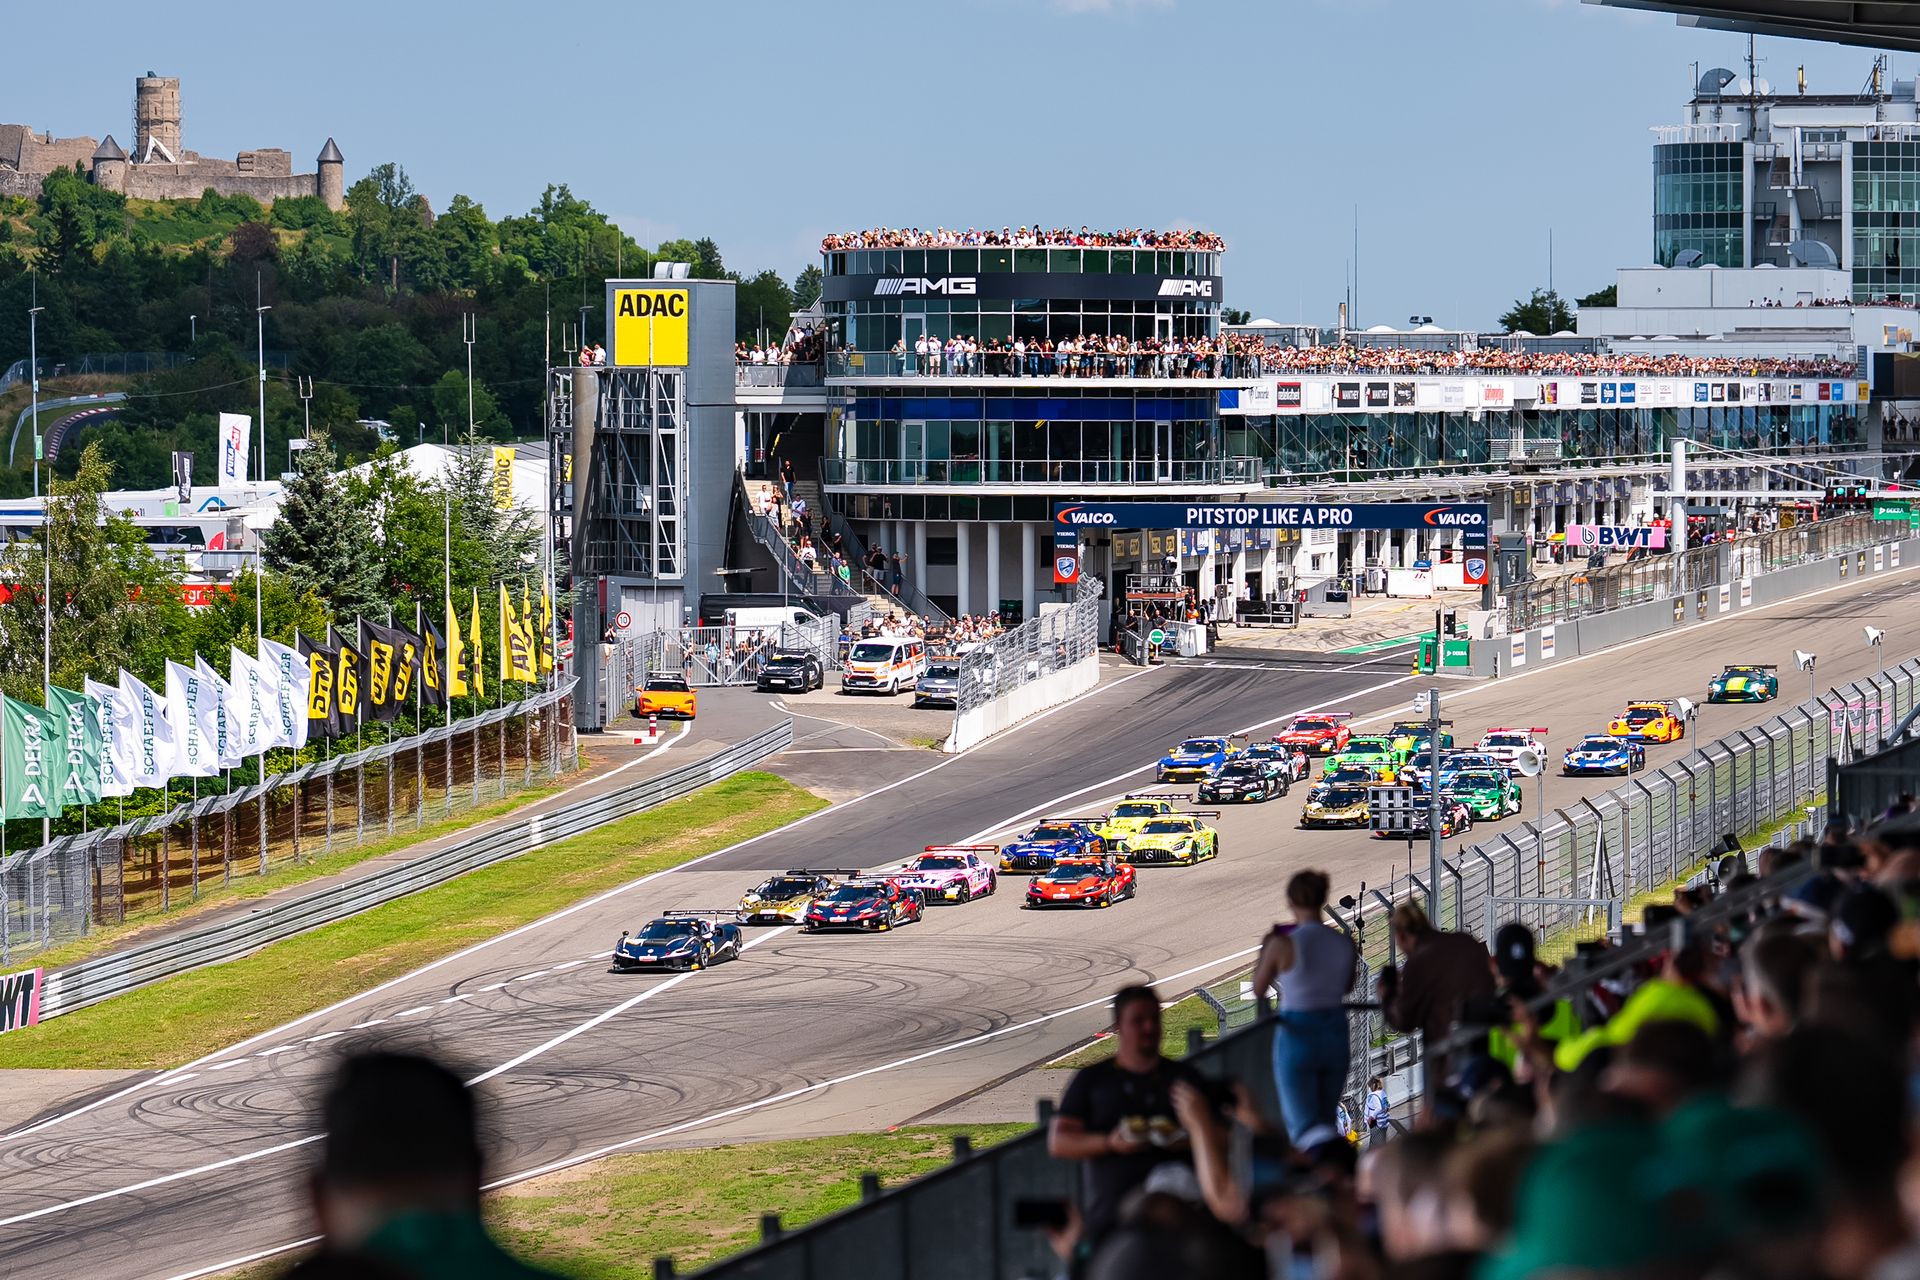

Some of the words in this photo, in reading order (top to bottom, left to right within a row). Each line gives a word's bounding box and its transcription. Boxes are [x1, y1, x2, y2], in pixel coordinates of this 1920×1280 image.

[618, 293, 685, 317] ADAC
[1071, 512, 1115, 525] VAICO
[1186, 507, 1260, 525] PITSTOP
[1262, 507, 1300, 525] LIKE
[1301, 507, 1315, 525] A
[1317, 507, 1354, 525] PRO
[1438, 513, 1483, 526] VAICO
[1598, 526, 1653, 546] BWT
[619, 616, 628, 625] 10
[313, 659, 331, 714] DTM
[186, 677, 199, 766] SCHAEFFLER
[66, 700, 85, 766] DEKRA
[23, 713, 42, 777] DEKRA
